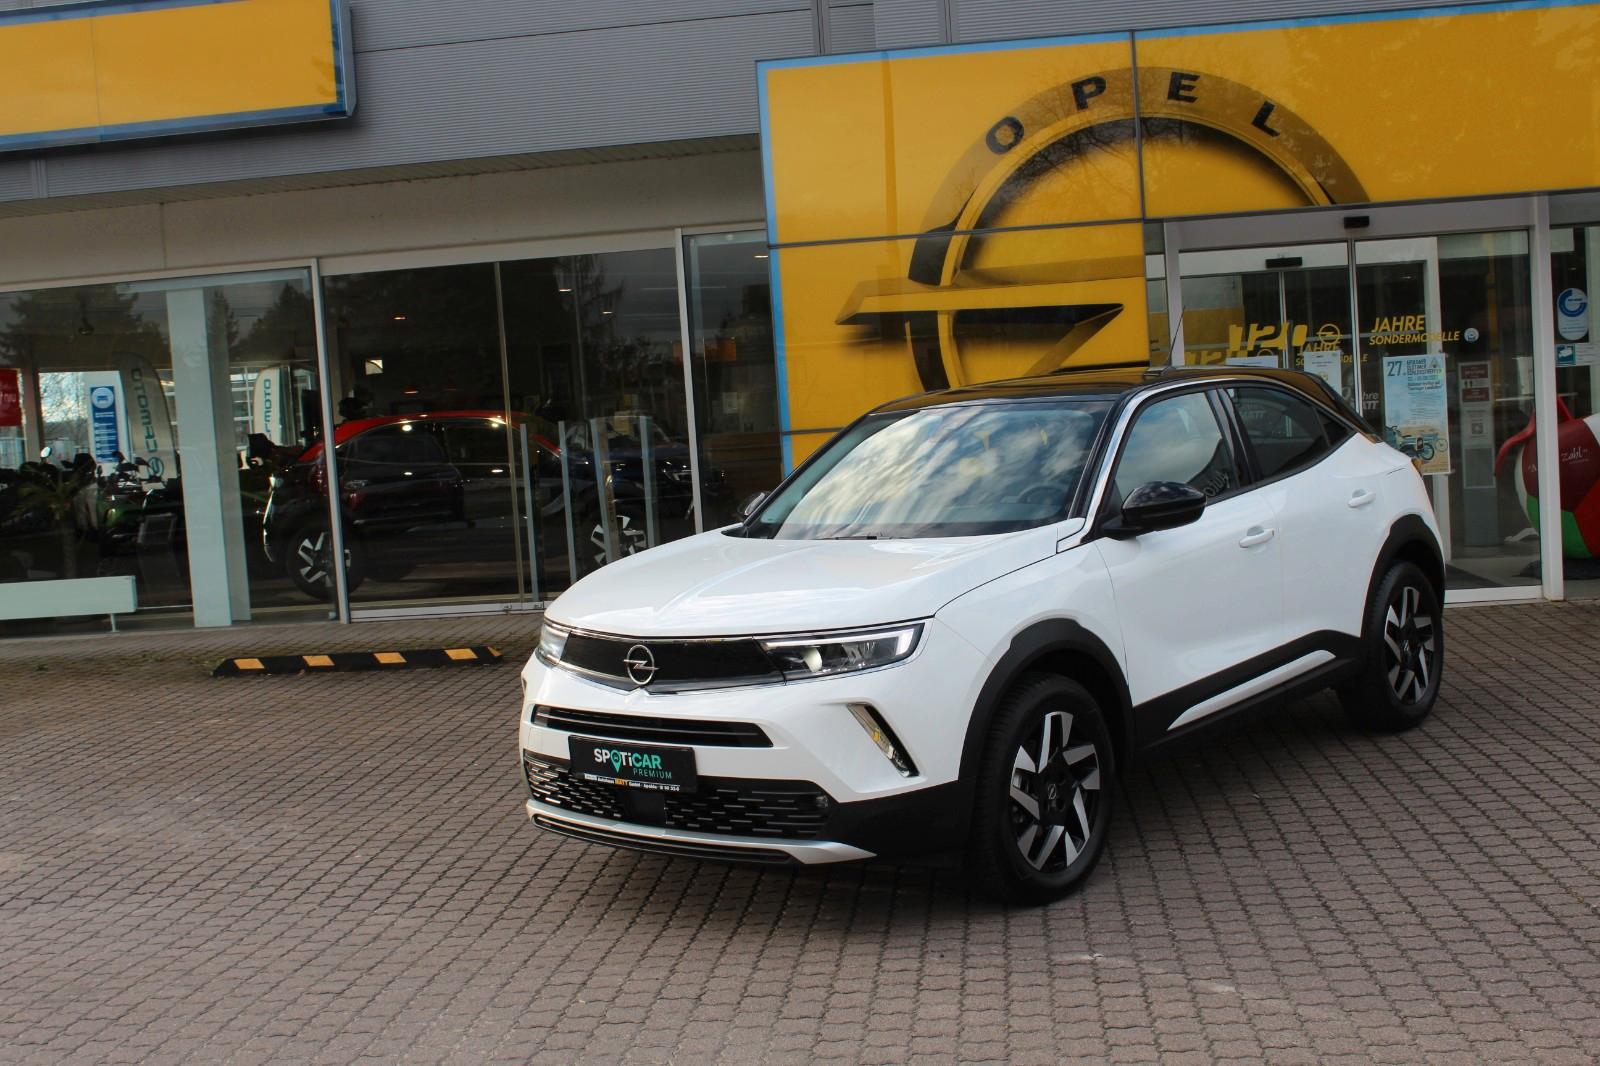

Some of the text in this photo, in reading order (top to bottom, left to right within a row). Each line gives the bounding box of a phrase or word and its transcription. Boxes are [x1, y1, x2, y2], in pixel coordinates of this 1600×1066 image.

[986, 72, 1281, 155] OPEL
[1371, 315, 1425, 333] JAHRE
[1369, 331, 1461, 345] SONDERMODELLE
[633, 768, 672, 779] PREMIUM
